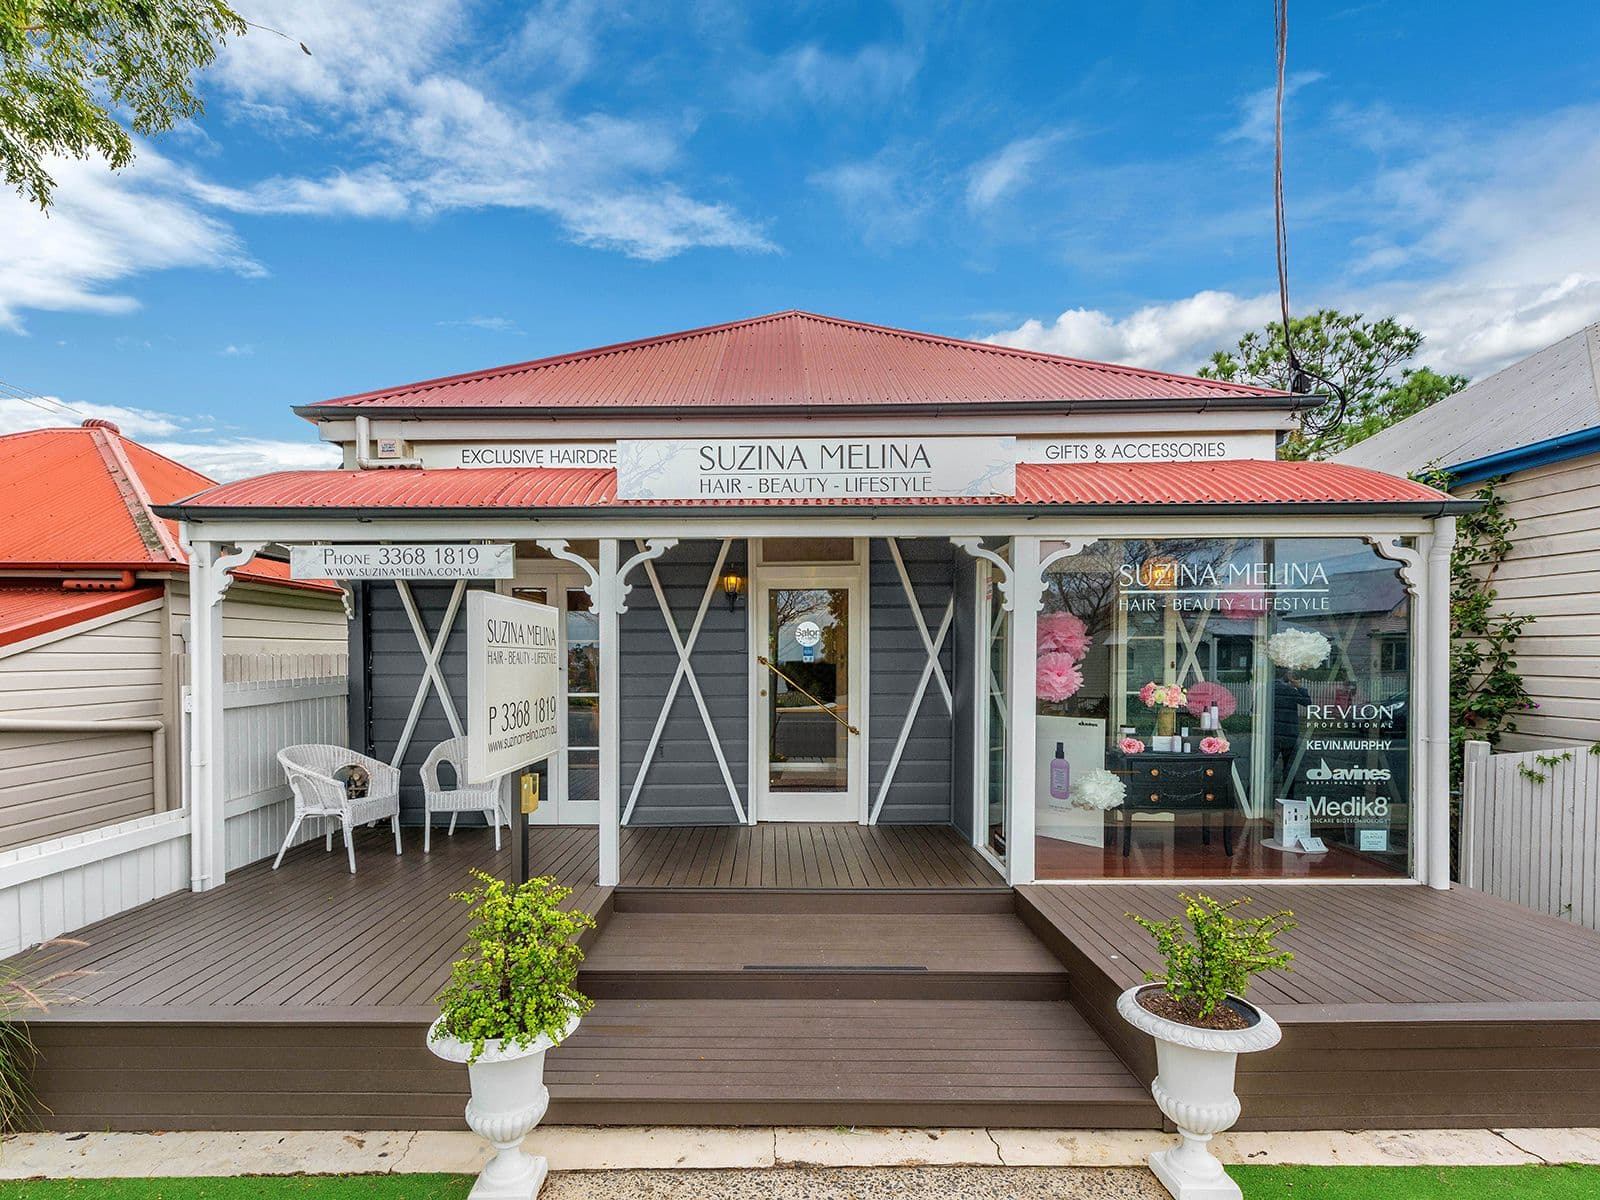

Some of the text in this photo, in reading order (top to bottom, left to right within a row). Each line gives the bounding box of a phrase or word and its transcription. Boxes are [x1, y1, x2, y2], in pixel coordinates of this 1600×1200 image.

[461, 449, 617, 464] EXCLUSIVE HAIRDRE
[699, 444, 932, 471] SUZINA MELINA
[1045, 442, 1226, 460] GIFTS & ACCESSORIES
[699, 478, 742, 494] HAIR
[759, 477, 828, 494] BEAUTY
[845, 476, 932, 493] LIFESTYLE
[323, 547, 479, 565] PHONE 3368 1819
[324, 567, 480, 577] WWW.SUZINAMELINA.COM.AU
[1119, 562, 1329, 587] SUZINA MELINA
[1119, 599, 1156, 612] HAIR
[1173, 598, 1235, 611] BEAUTY
[1251, 597, 1329, 611] LIFESTYLE
[487, 619, 557, 647] SUZINA MELINA
[487, 651, 504, 665] HAIR
[489, 696, 556, 736] P 3368 1819
[1306, 704, 1394, 720] REVLON
[1306, 740, 1392, 750] KEVIN.MURPHY
[1305, 796, 1389, 817] Medik8
